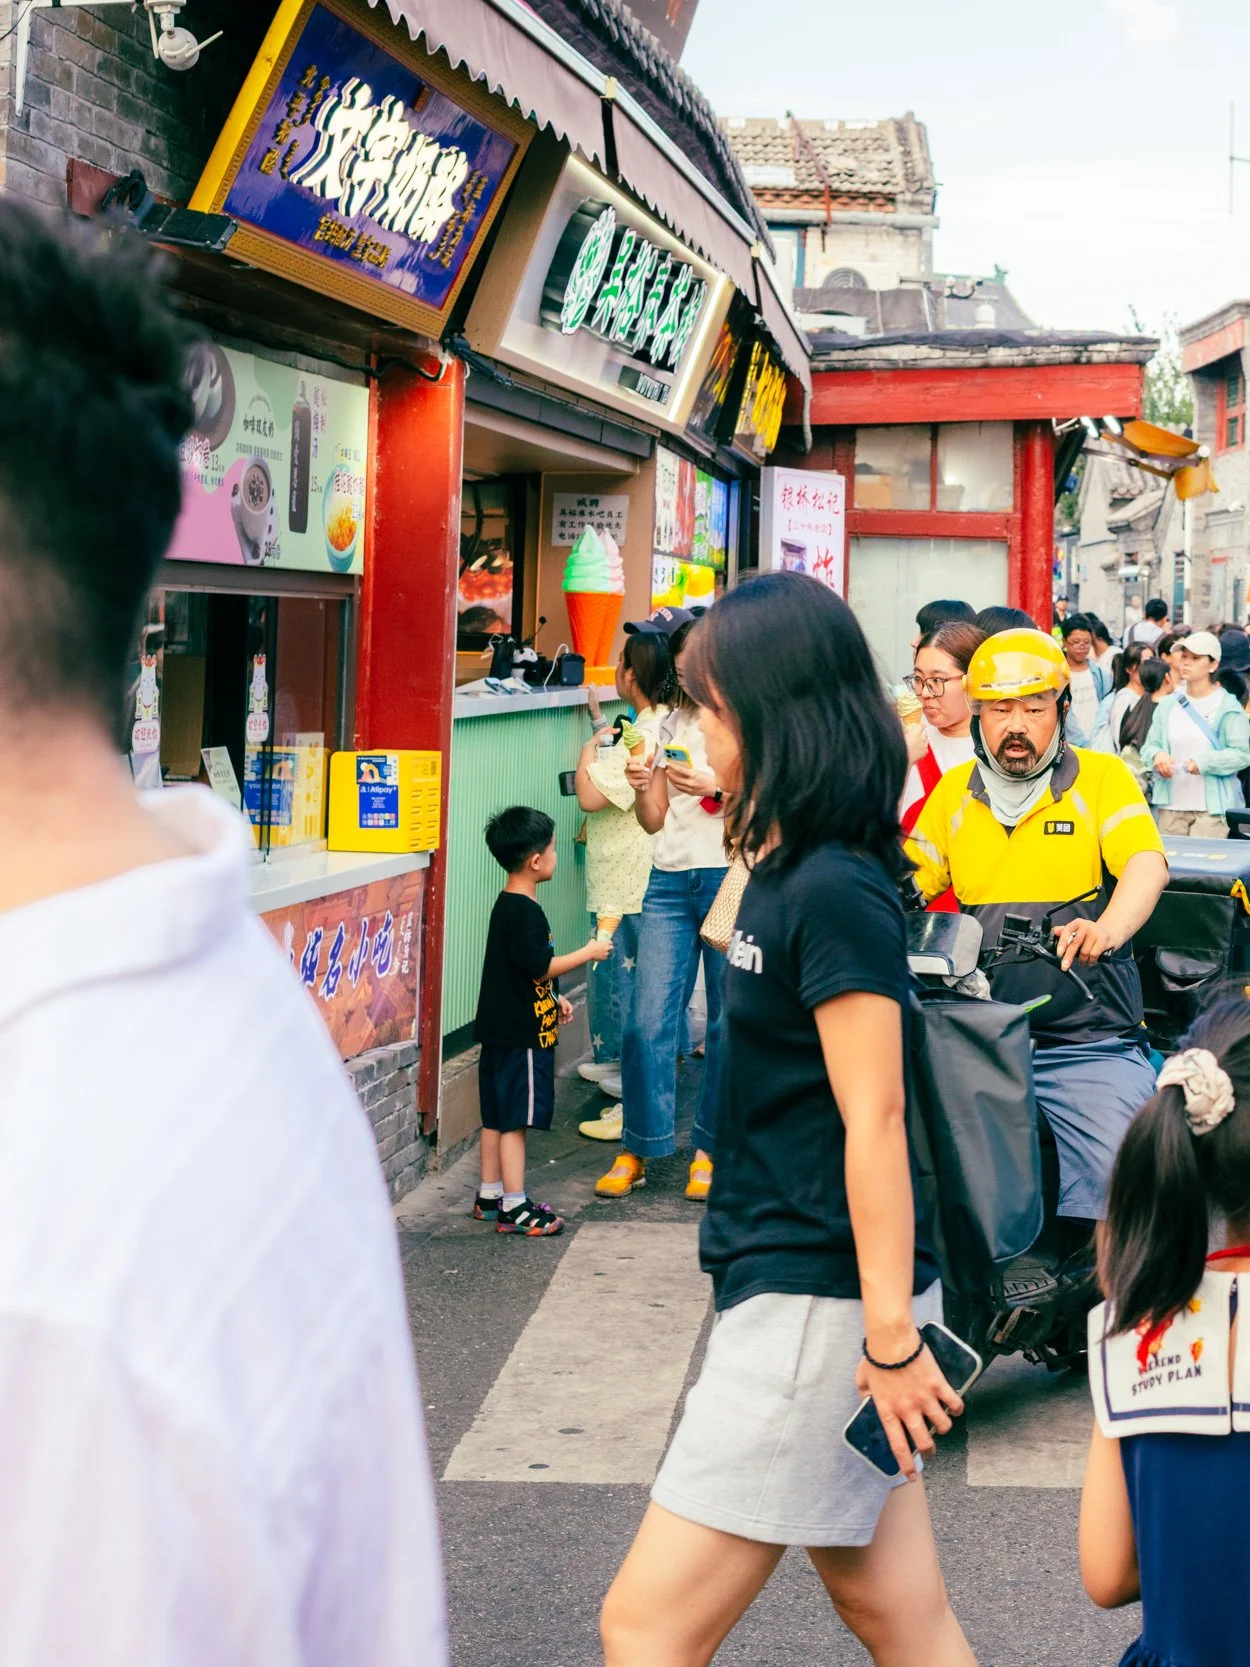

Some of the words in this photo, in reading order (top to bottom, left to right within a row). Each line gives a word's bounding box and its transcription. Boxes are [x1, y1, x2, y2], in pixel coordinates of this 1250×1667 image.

[290, 76, 469, 244] 文宇奶酪
[1131, 1373, 1162, 1396] STUDY
[1167, 1364, 1202, 1383] PLAN
